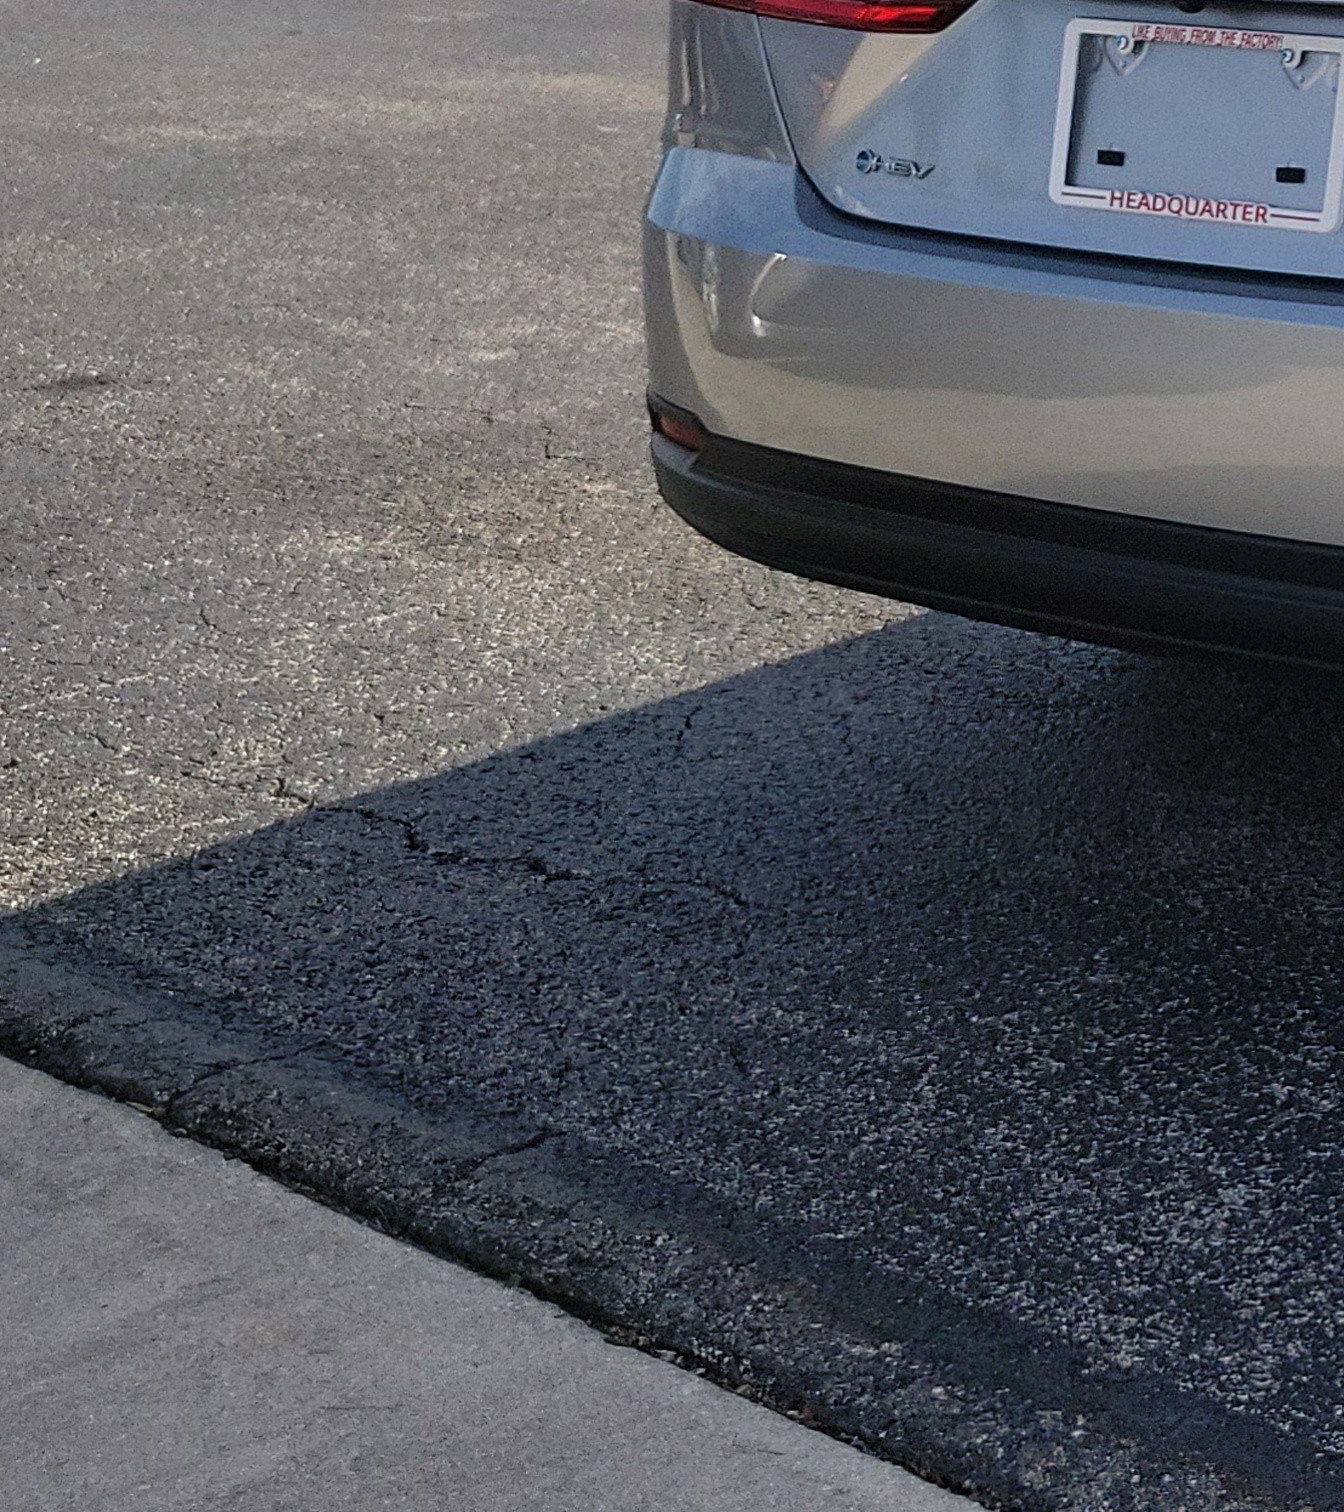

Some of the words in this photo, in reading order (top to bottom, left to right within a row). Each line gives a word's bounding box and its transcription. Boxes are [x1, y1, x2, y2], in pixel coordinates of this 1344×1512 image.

[1132, 24, 1151, 39] LIKE
[1154, 26, 1187, 43] BUYING
[1191, 29, 1216, 45] FROM
[1220, 31, 1238, 47] THE
[1109, 190, 1268, 223] HEADQUARTER
